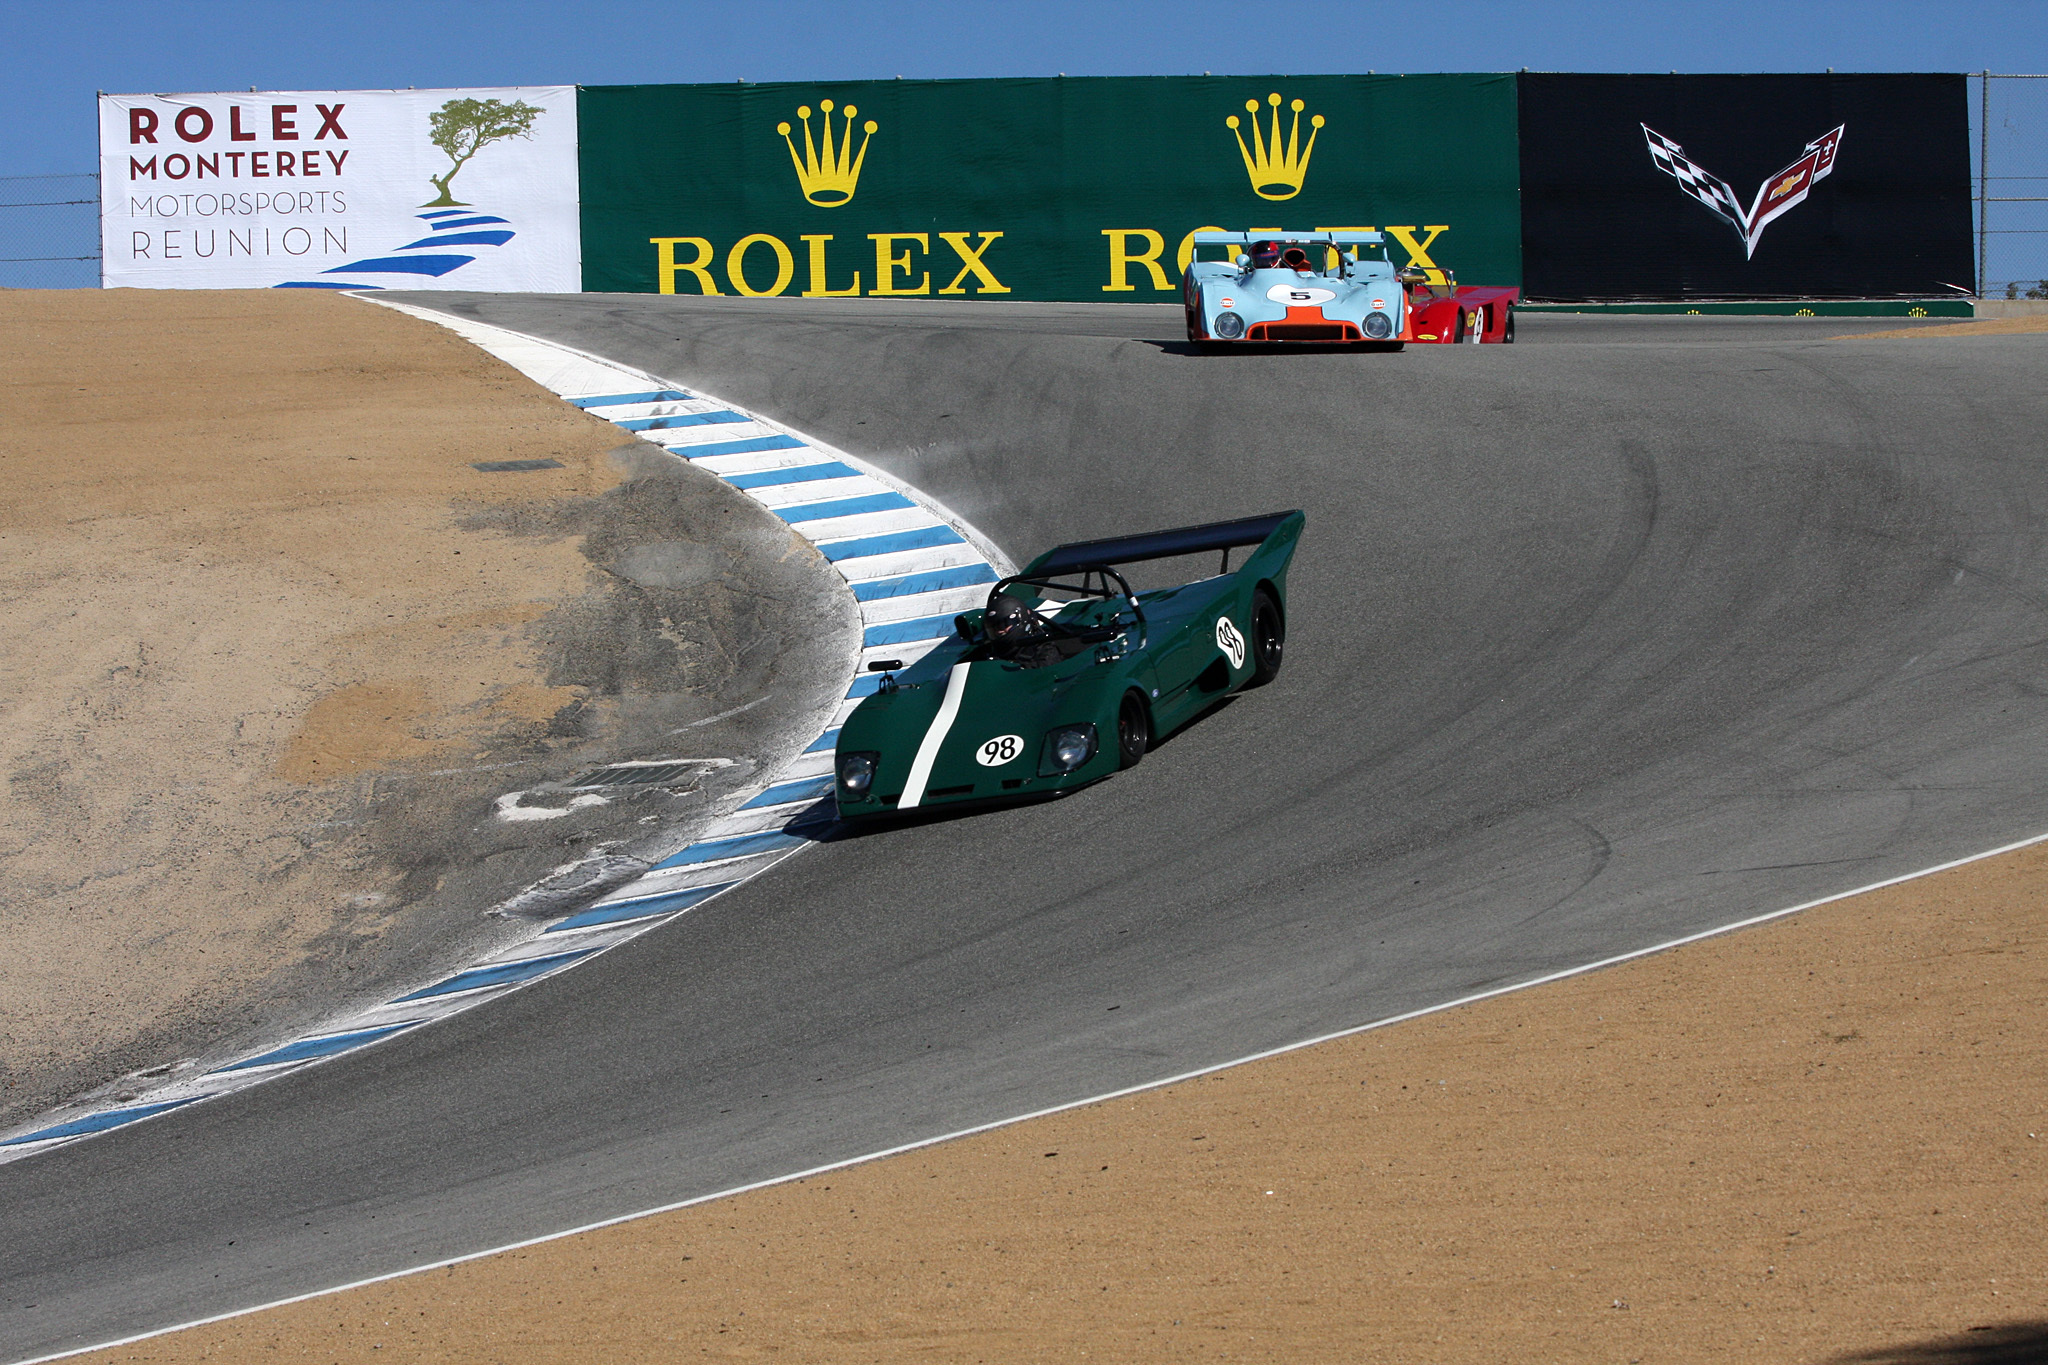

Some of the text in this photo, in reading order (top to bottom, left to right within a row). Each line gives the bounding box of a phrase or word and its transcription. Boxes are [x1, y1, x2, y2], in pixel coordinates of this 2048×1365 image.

[129, 104, 349, 144] ROLEX
[130, 150, 349, 180] MONTEREY
[131, 191, 346, 217] MOTORSPORTS
[132, 226, 347, 259] REUNION
[1101, 225, 1457, 291] ROX
[650, 231, 1011, 298] ROLEX
[1290, 291, 1312, 301] 5
[1218, 620, 1244, 665] 98
[984, 736, 1016, 765] 98
